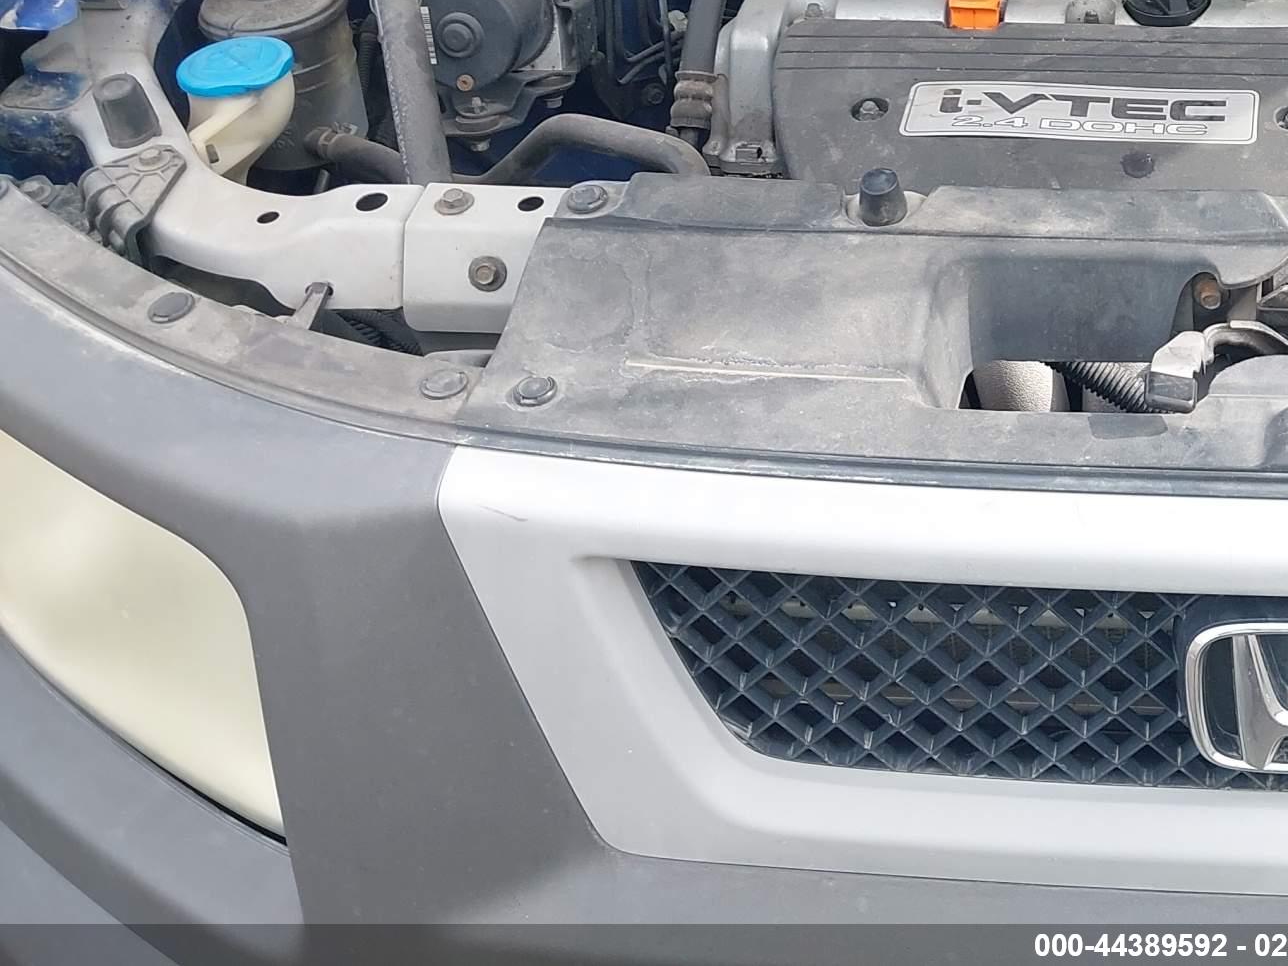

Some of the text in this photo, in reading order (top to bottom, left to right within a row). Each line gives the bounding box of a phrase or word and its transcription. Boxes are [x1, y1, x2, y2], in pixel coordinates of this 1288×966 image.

[938, 88, 1228, 122] i-VTEC
[951, 115, 1209, 136] 2.4 DOHC
